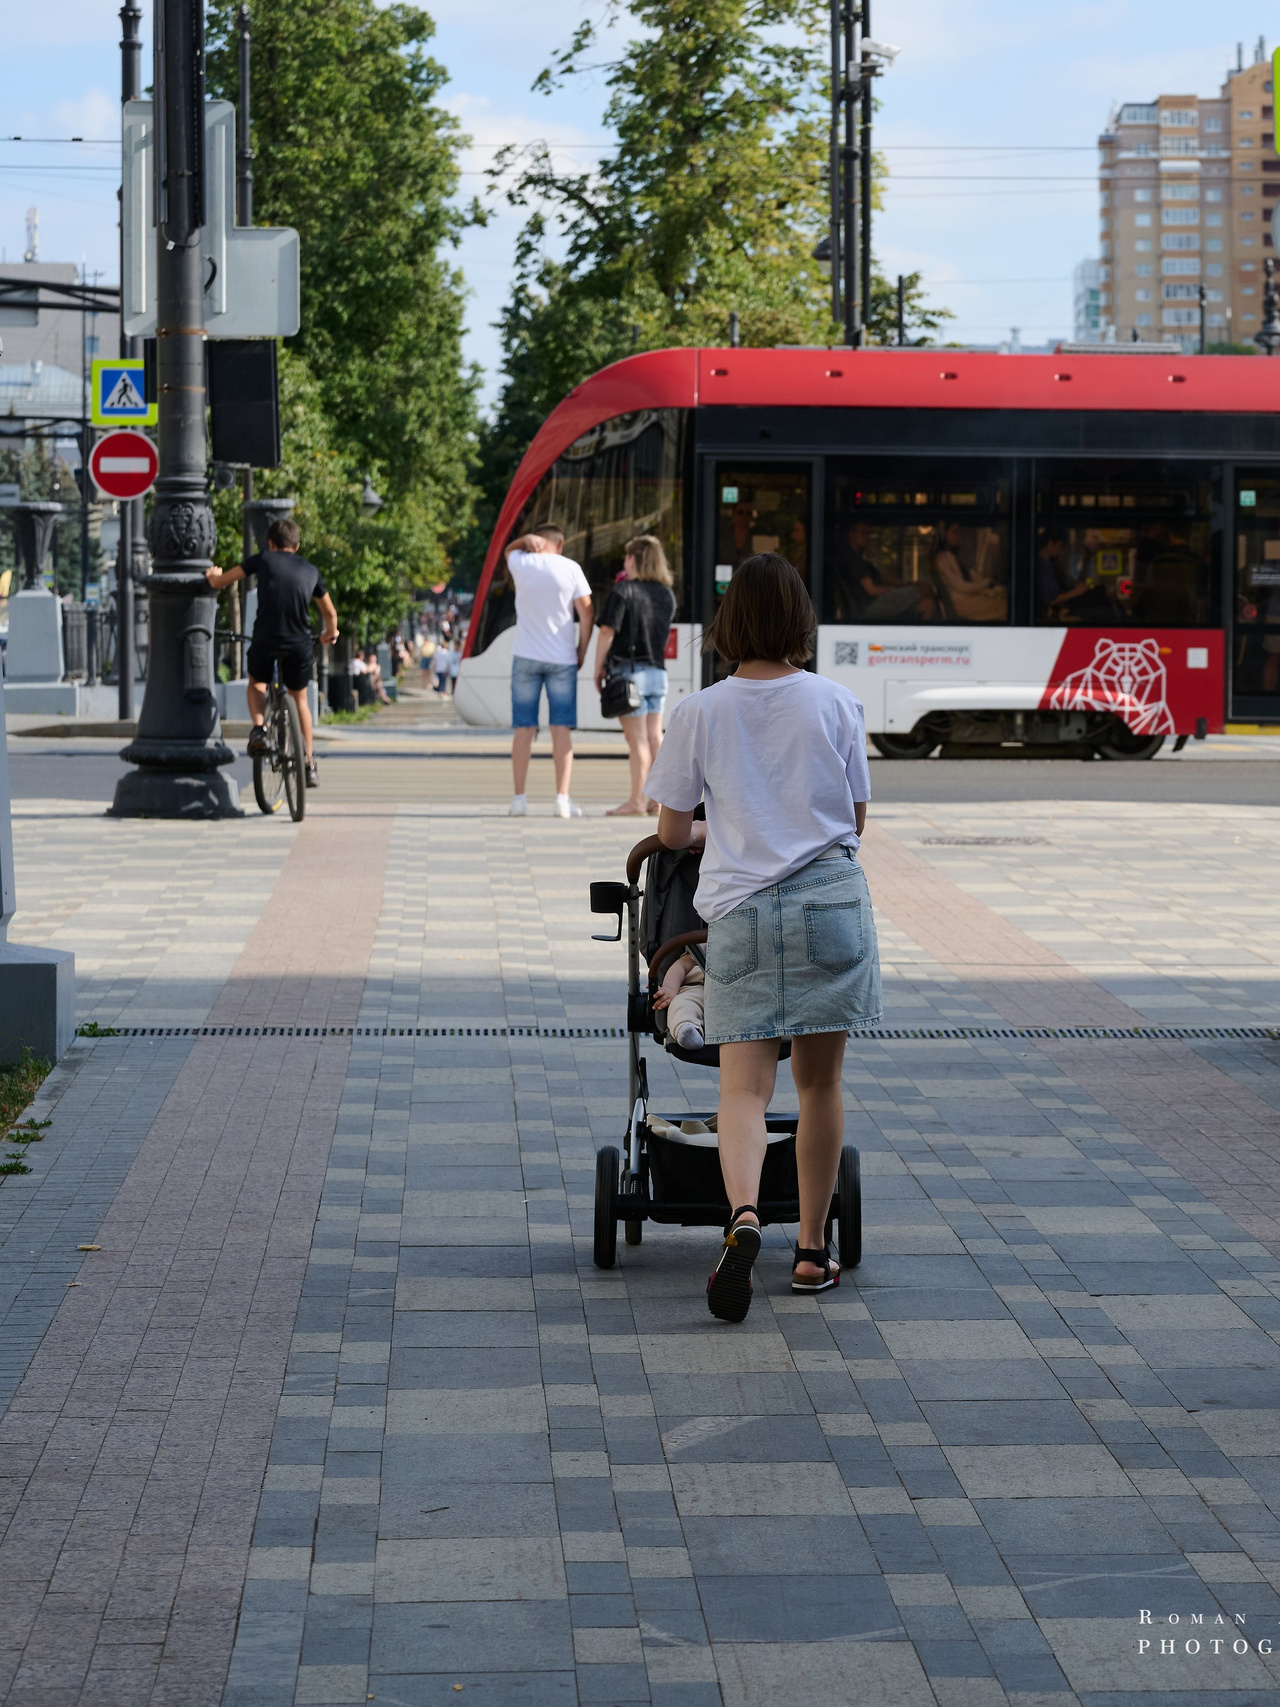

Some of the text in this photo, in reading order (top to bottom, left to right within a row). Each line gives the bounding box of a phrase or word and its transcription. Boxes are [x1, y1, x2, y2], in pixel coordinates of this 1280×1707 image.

[868, 642, 969, 653] рмский транспорт
[868, 654, 970, 667] gortransperm.ru
